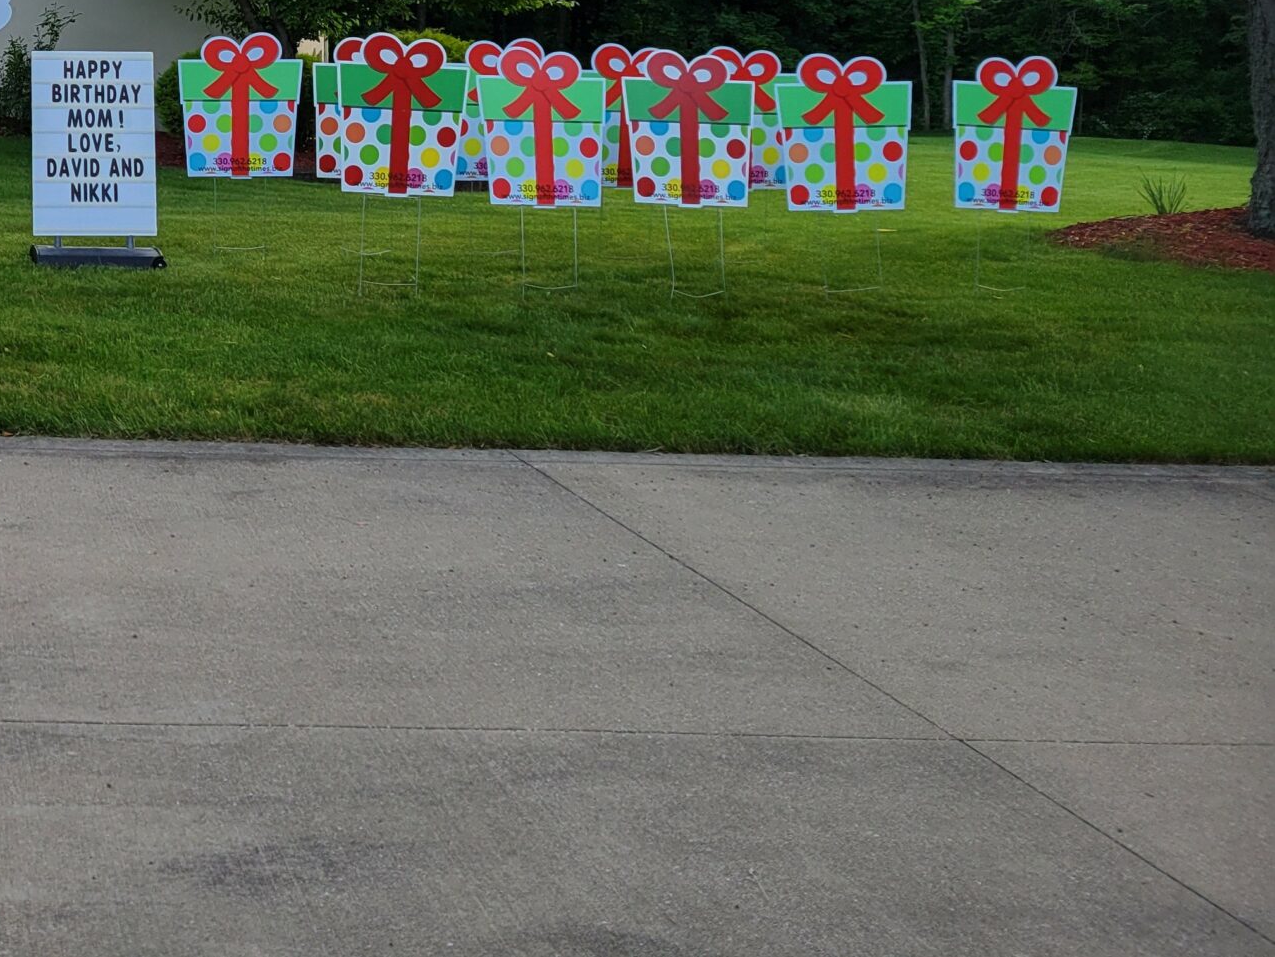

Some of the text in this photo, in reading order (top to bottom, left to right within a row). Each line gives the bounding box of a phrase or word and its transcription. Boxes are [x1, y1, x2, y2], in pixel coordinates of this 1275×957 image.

[63, 60, 123, 79] HAPPY
[51, 84, 141, 104] BIRTHDAY
[67, 133, 121, 153] LOVE,
[46, 158, 144, 178] DAVID AND
[197, 164, 283, 174] www.signetimes.bz
[212, 157, 267, 166] 330.962.6218
[70, 182, 119, 203] NIKKI
[517, 184, 574, 193] 330.962.6218
[662, 183, 720, 193] 330..6218
[981, 188, 1035, 199] 330.92.6218
